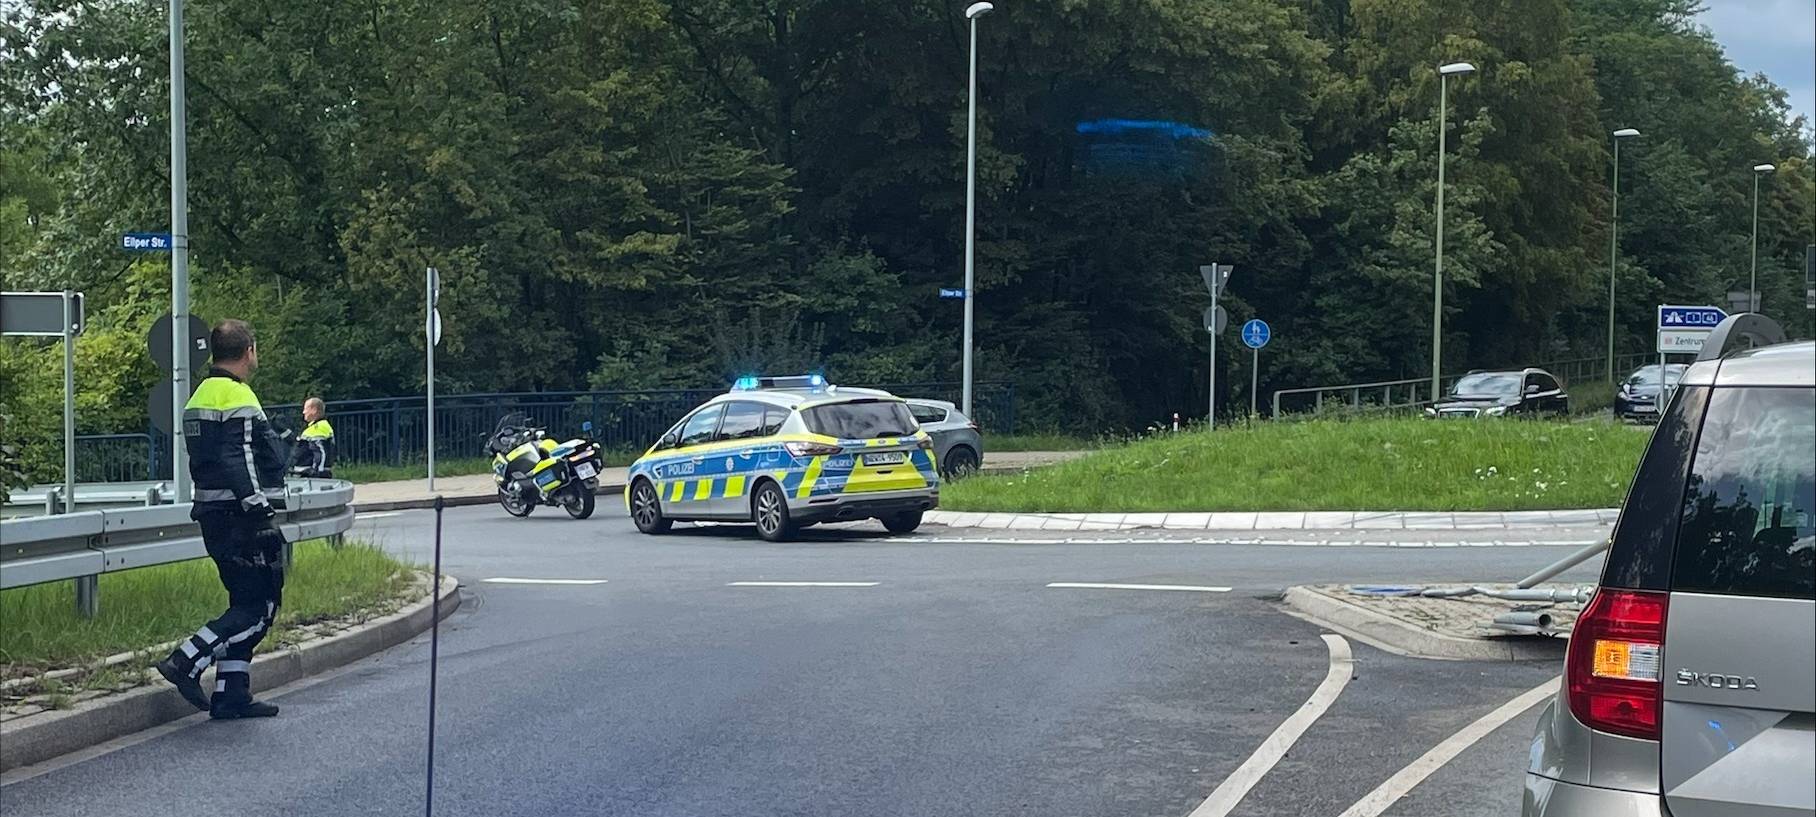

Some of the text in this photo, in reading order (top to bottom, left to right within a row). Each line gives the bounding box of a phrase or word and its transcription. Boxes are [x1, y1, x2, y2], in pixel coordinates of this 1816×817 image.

[123, 236, 168, 249] Eilper Str.
[667, 462, 695, 476] POLIZEI
[1676, 667, 1760, 691] ŠKODA
